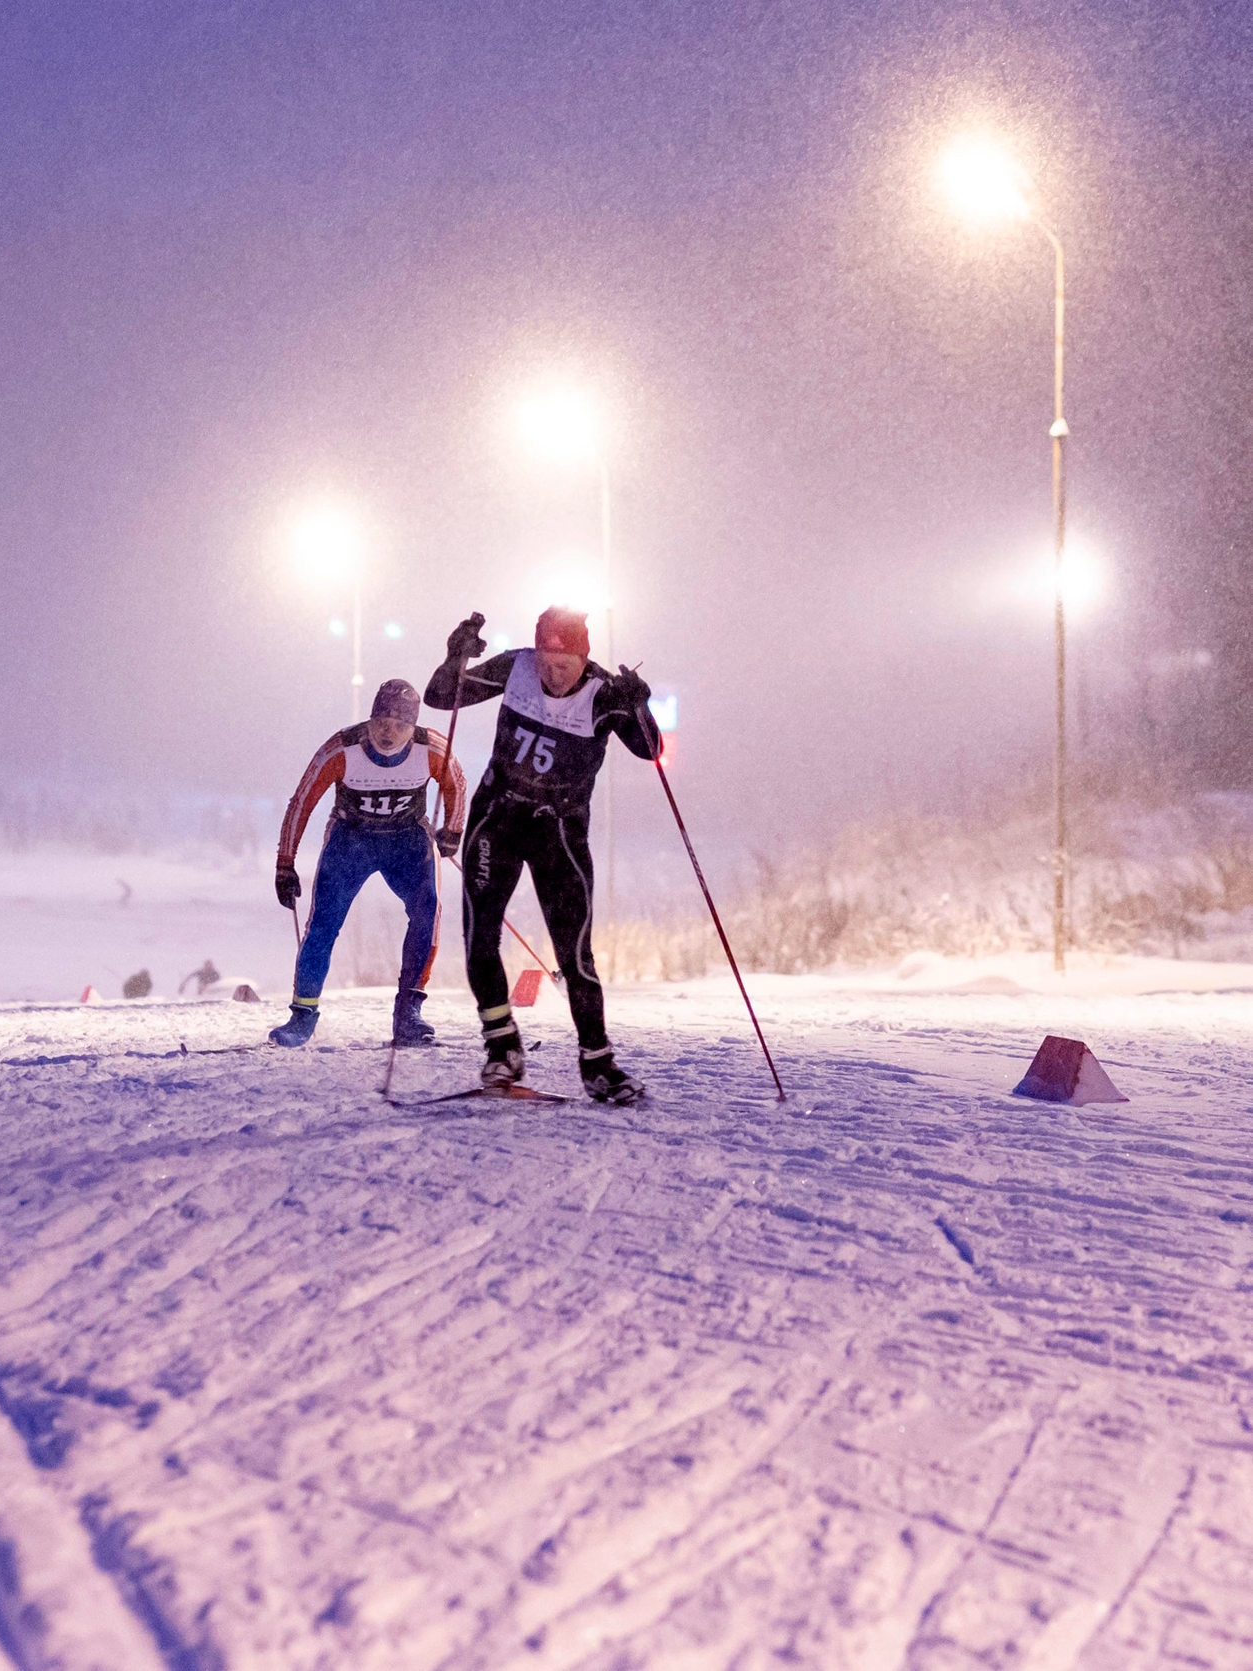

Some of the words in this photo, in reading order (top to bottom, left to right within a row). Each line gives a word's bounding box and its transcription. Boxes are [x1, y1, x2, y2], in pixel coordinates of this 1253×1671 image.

[514, 726, 557, 774] 75
[359, 795, 412, 815] 112
[477, 839, 490, 879] CRAFT
